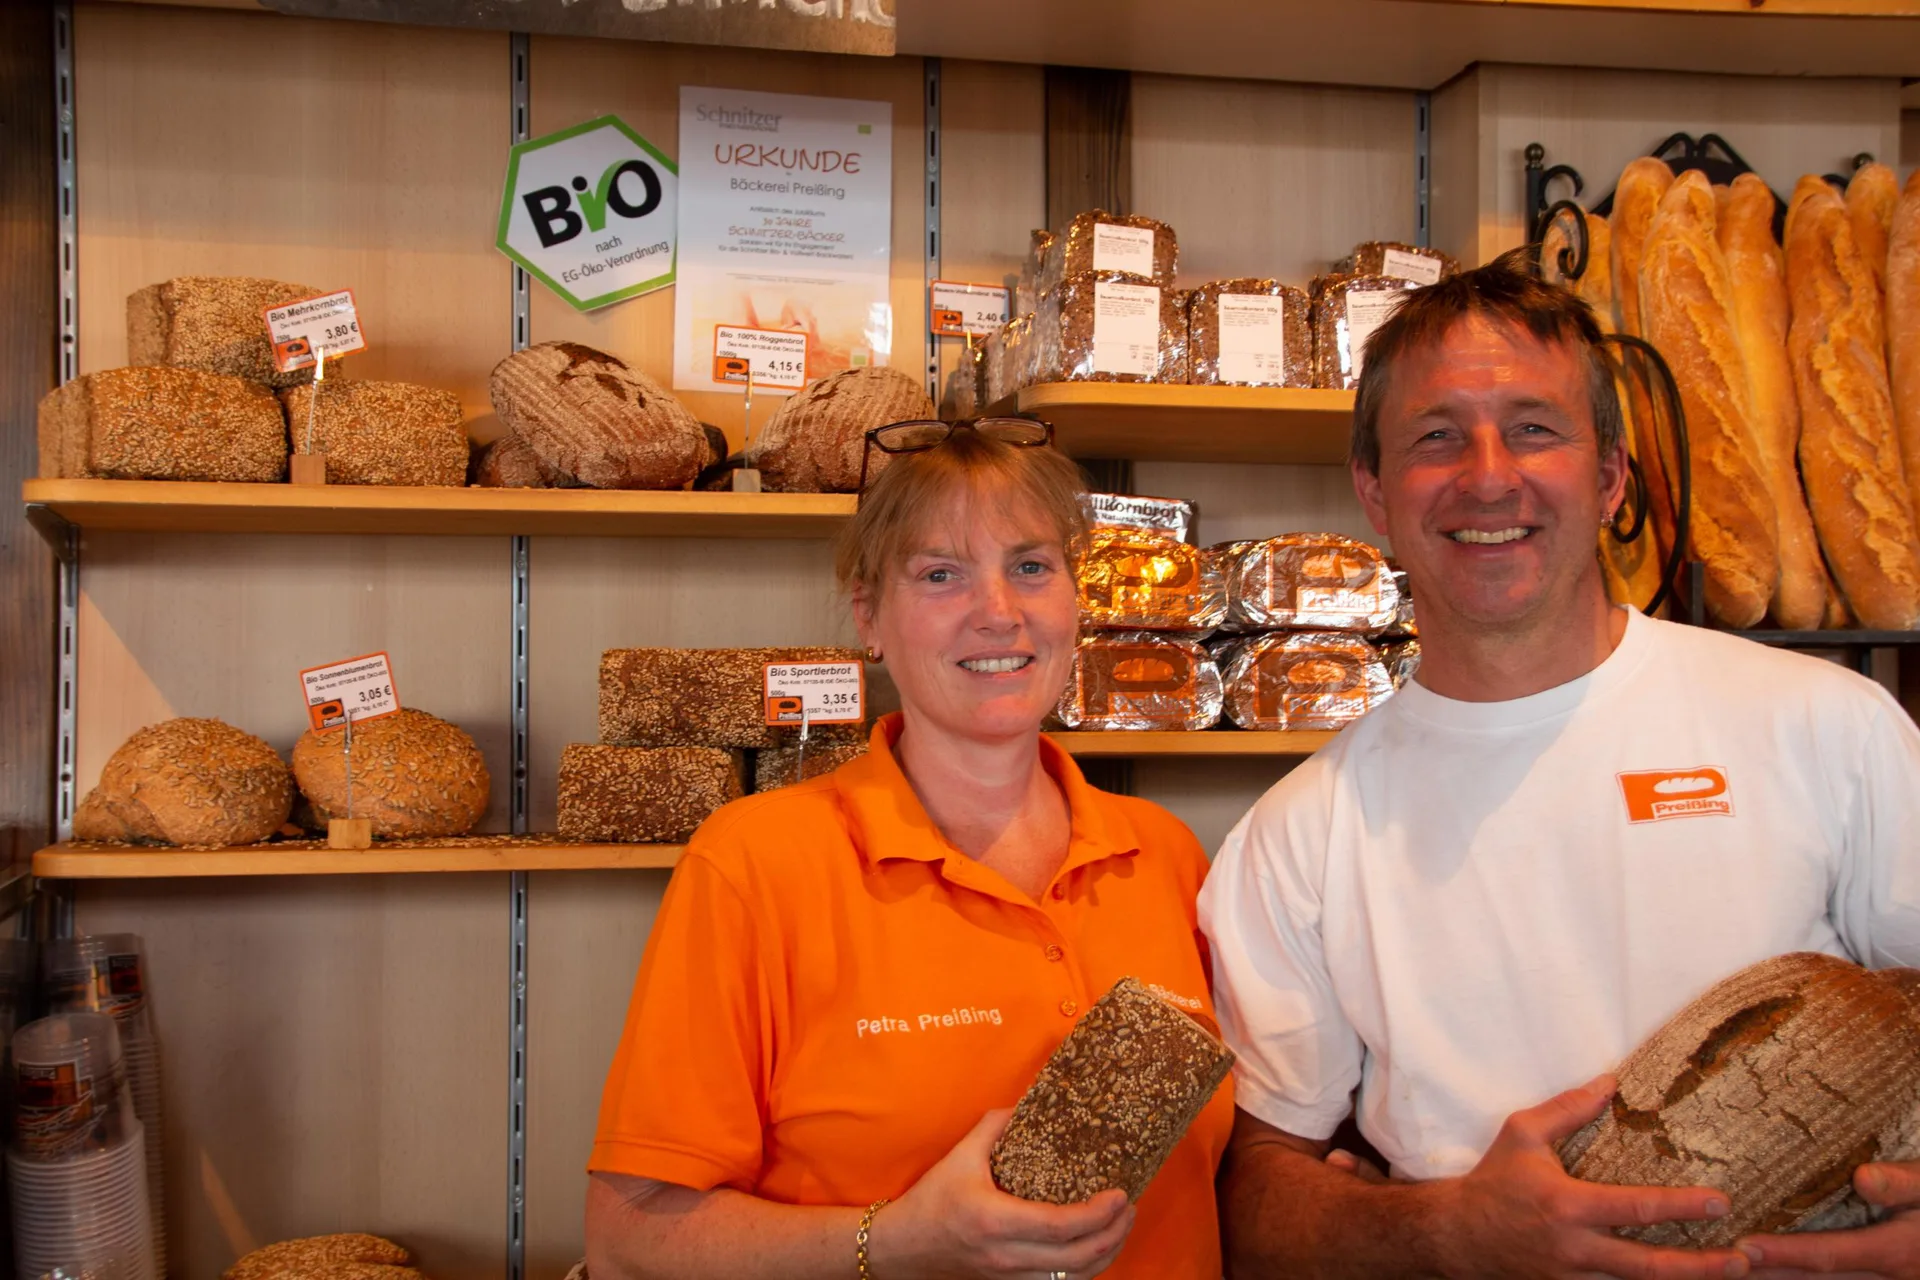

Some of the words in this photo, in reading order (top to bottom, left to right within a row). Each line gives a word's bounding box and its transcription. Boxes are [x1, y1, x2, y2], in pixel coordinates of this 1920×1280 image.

[696, 104, 782, 126] Schnitzer
[714, 143, 862, 174] URKUNDE
[730, 177, 789, 193] Bäckerei
[792, 182, 845, 200] Preißing
[595, 235, 623, 253] nach
[561, 240, 669, 283] EG-Öko-Verordnung
[270, 312, 286, 322] Bio
[287, 296, 349, 318] Mehrkornbrot
[976, 311, 997, 322] 2,40
[1000, 313, 1008, 323] €
[325, 324, 349, 340] 3,80
[350, 321, 358, 333] €
[719, 330, 733, 339] Bio
[737, 332, 757, 341] 100%
[759, 334, 804, 346] Roggenbrot
[768, 360, 793, 372] 4,15
[795, 362, 803, 373] €
[305, 675, 318, 684] Bio
[319, 660, 383, 681] Sonnenblumenbrot
[770, 667, 787, 677] Bio
[790, 666, 851, 678] Sportlerbrot
[358, 687, 382, 702] 3,05
[384, 684, 392, 696] €
[822, 693, 848, 705] 3,35
[850, 692, 859, 704] €
[1655, 799, 1730, 815] Preißing
[856, 1015, 911, 1038] Petra
[917, 1006, 1003, 1031] Preißing
